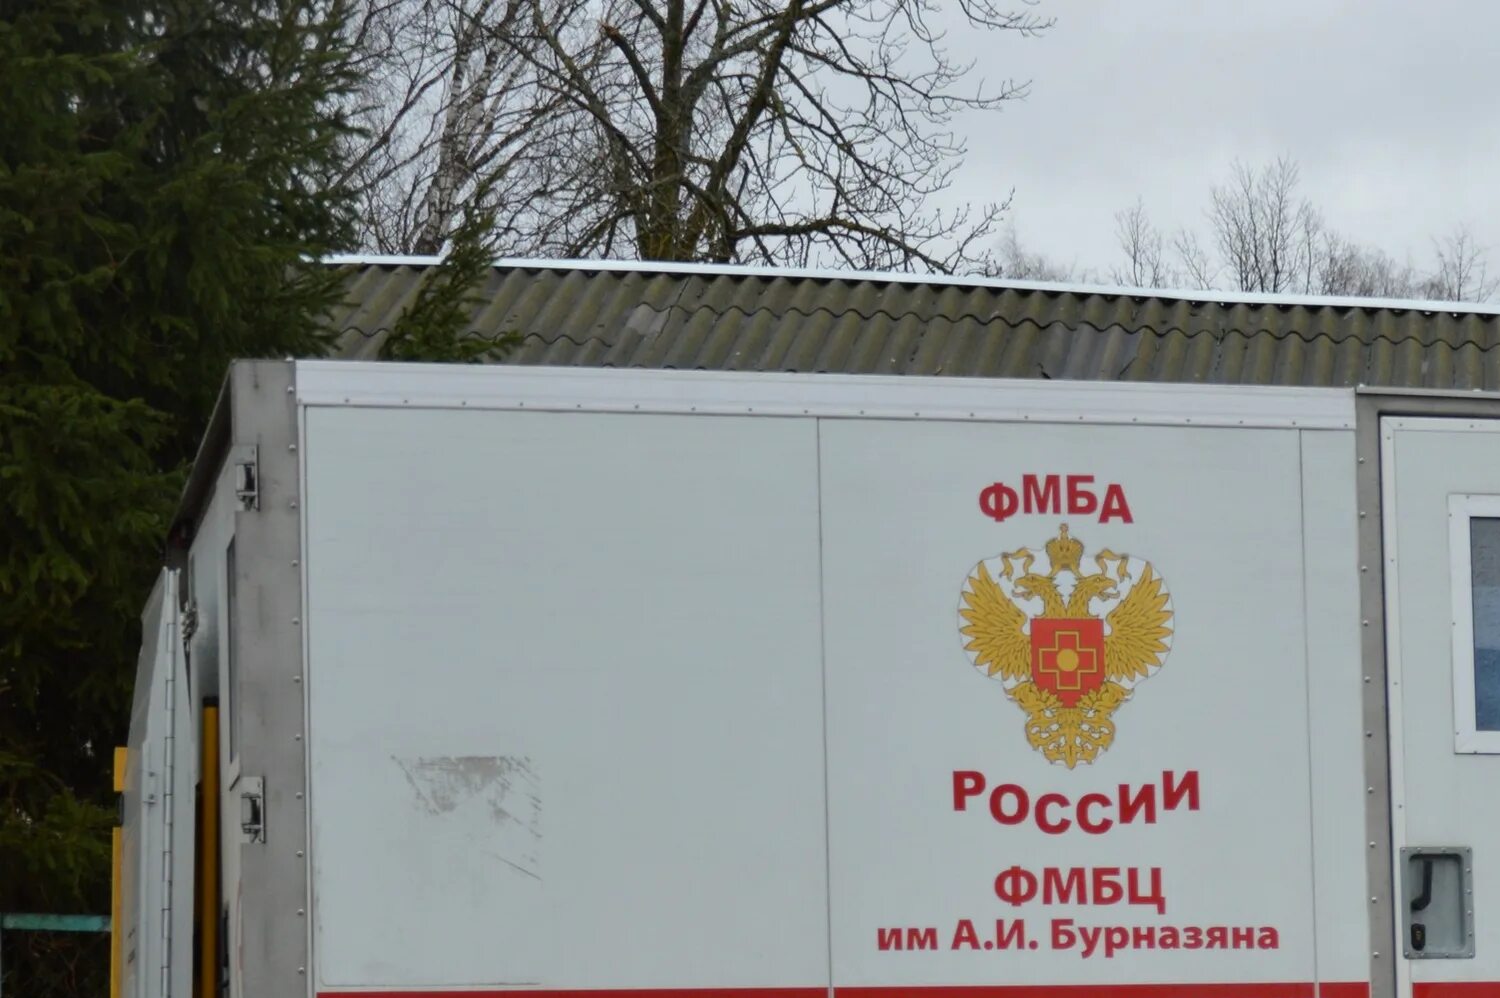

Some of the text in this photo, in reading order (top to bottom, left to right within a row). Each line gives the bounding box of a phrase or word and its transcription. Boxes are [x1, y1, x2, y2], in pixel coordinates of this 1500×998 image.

[980, 474, 1133, 524] ФМБА
[952, 770, 1200, 835] РОССИИ
[994, 866, 1166, 914] ФМБЦ
[878, 918, 1279, 957] им А.И. Бурназяна
